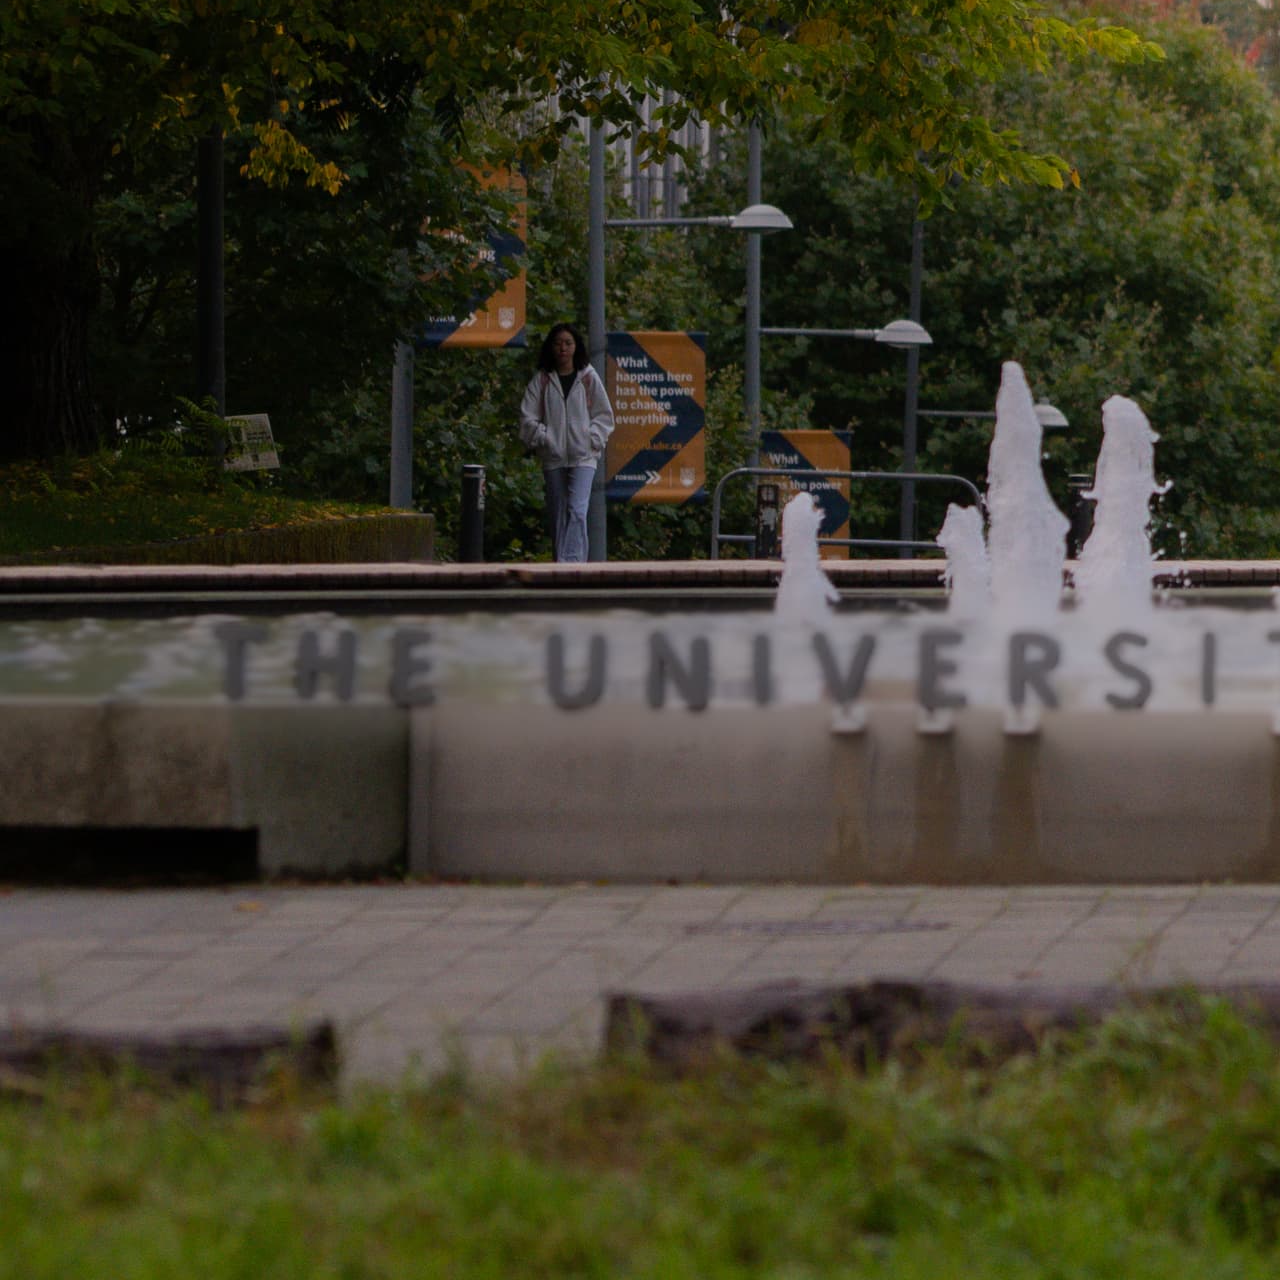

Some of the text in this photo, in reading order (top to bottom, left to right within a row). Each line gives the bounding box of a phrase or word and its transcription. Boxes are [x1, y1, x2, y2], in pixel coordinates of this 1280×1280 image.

[616, 357, 648, 368] What
[616, 371, 693, 383] happens here
[616, 384, 695, 398] has the power
[616, 400, 671, 411] to change
[615, 413, 677, 426] everything
[769, 453, 799, 465] What
[790, 480, 808, 490] the
[809, 481, 842, 492] power
[213, 623, 437, 709] THE
